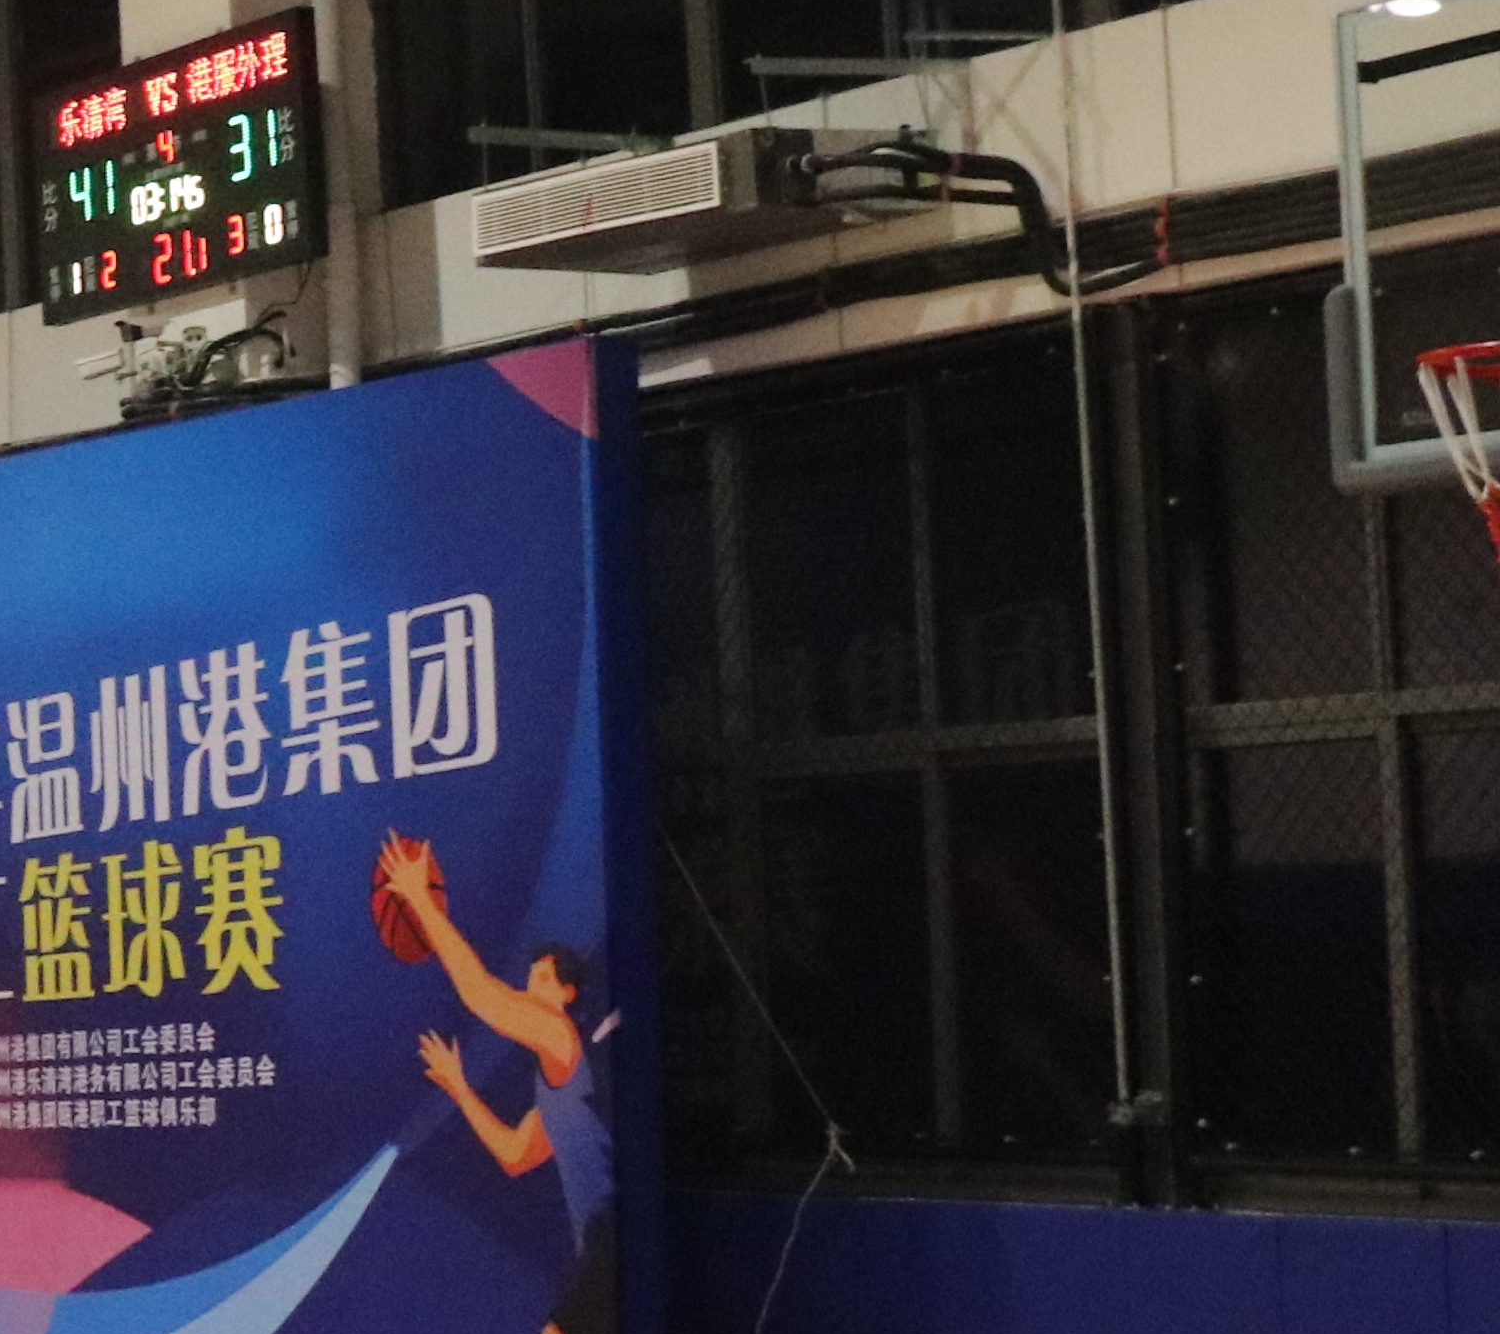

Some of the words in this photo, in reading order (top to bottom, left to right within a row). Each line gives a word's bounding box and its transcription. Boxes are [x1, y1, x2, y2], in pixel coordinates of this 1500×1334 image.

[143, 71, 179, 117] VS
[155, 130, 177, 163] 4
[227, 108, 279, 183] 31
[69, 159, 116, 222] 41
[226, 213, 246, 256] 3
[263, 203, 285, 246] 0
[71, 261, 84, 295] 1
[100, 249, 118, 290] 2
